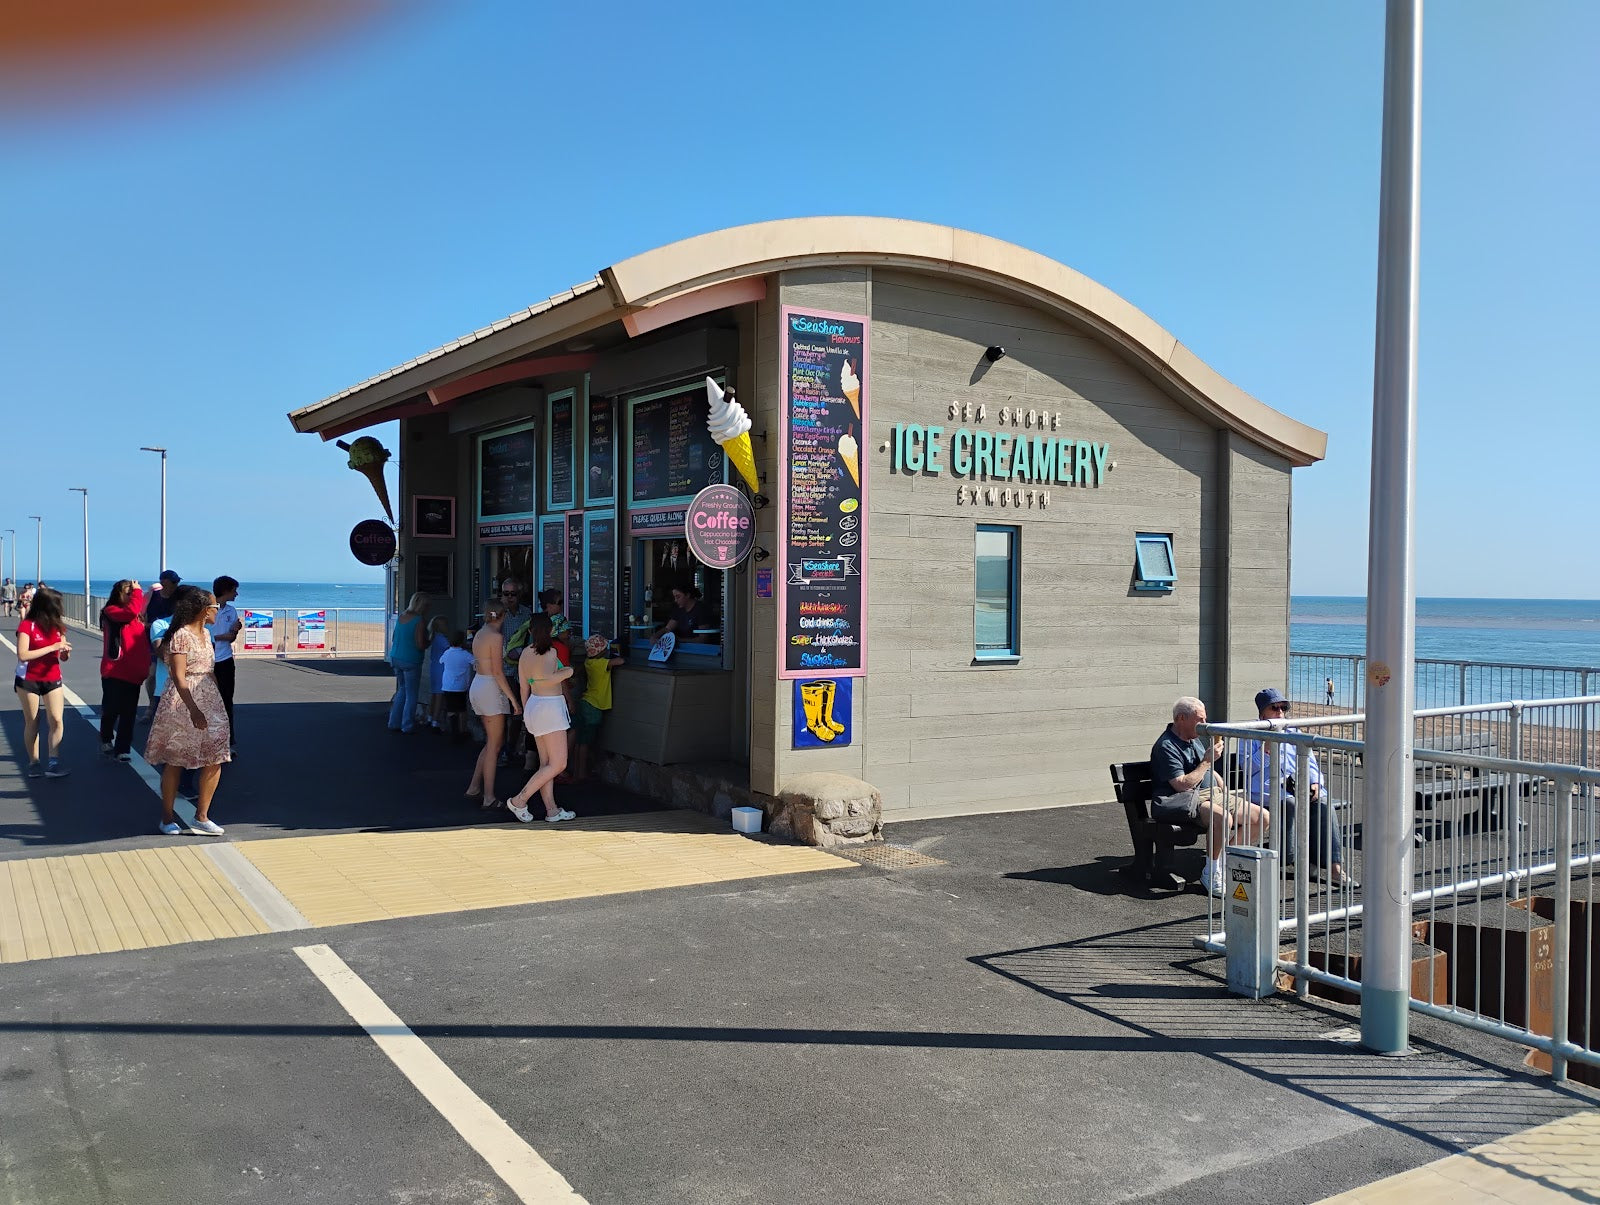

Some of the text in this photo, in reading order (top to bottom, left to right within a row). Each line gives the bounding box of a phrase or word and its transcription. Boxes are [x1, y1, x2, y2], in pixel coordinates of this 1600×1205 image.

[952, 401, 1062, 427] SEA SHORE
[895, 422, 1110, 485] ICE CREAMERY
[962, 485, 1051, 506] EXMOUTH
[633, 514, 649, 523] PLEASE
[649, 513, 667, 522] QUEUE
[667, 511, 684, 521] ALONG
[693, 511, 750, 529] Coffee
[354, 533, 392, 544] Coffee
